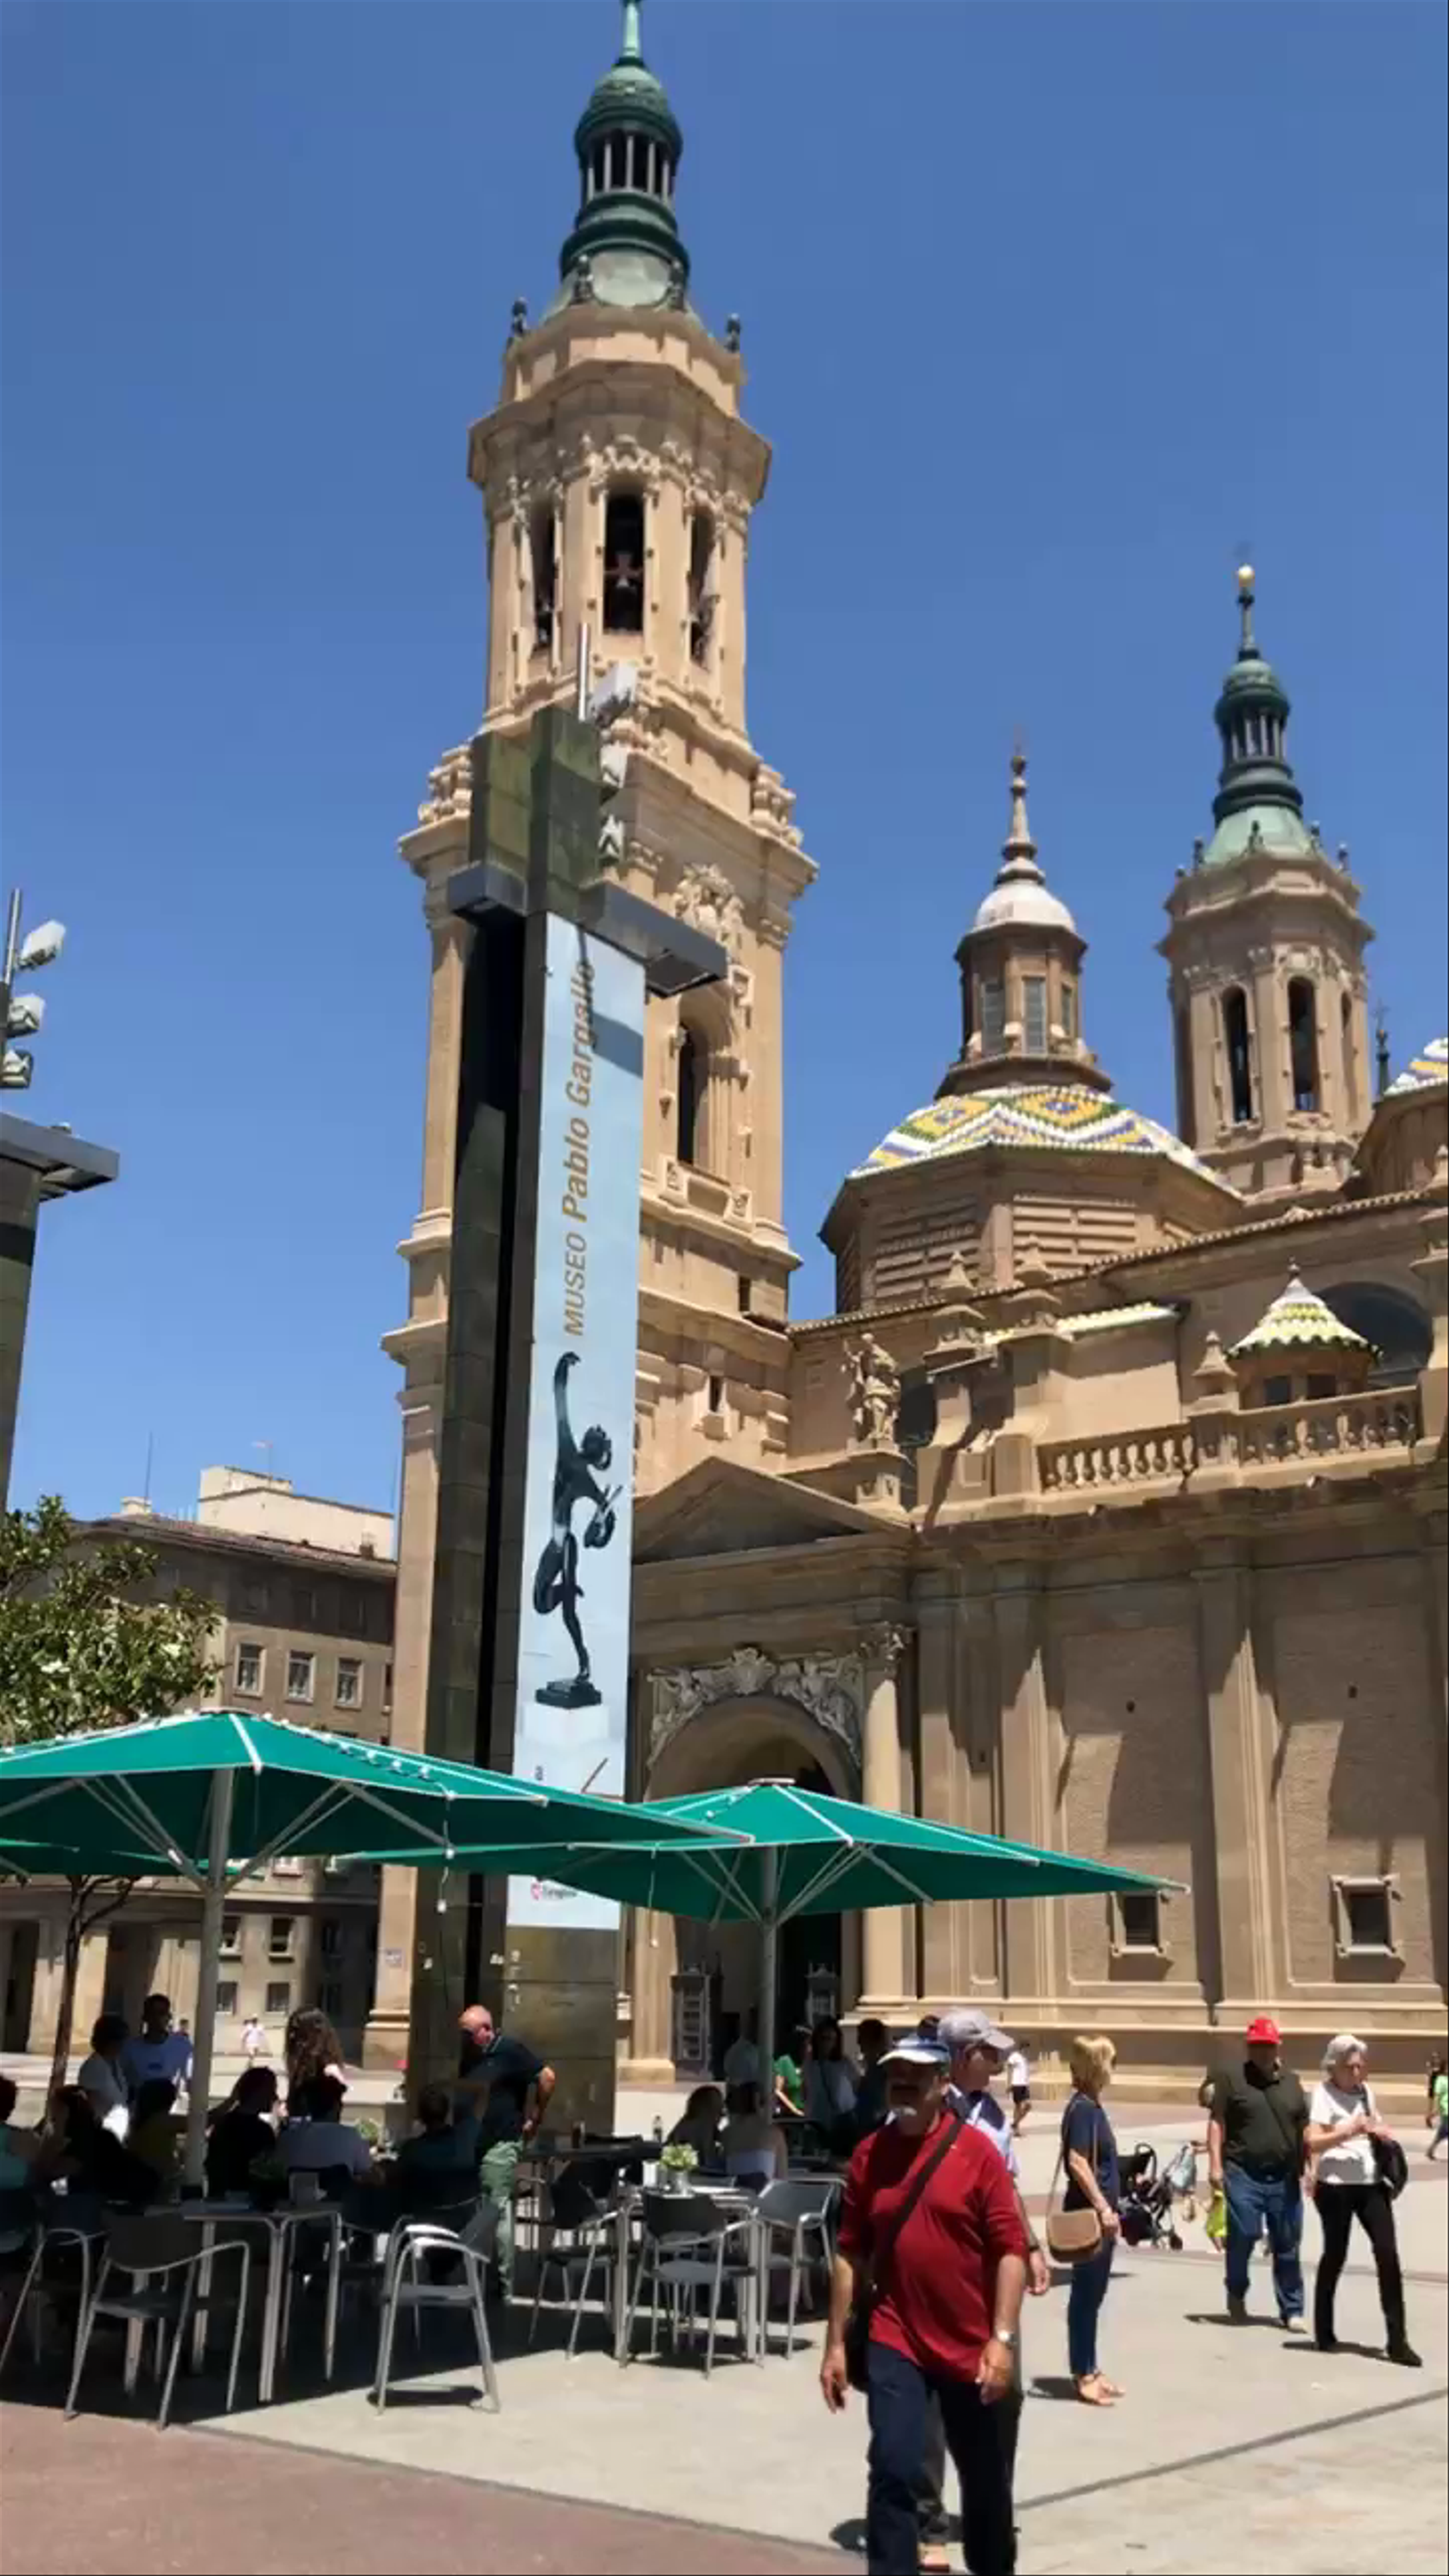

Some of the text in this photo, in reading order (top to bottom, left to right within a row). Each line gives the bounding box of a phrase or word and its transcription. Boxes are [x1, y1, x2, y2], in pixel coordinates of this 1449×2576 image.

[562, 958, 597, 1336] MUSEO Pablo Gargallo
